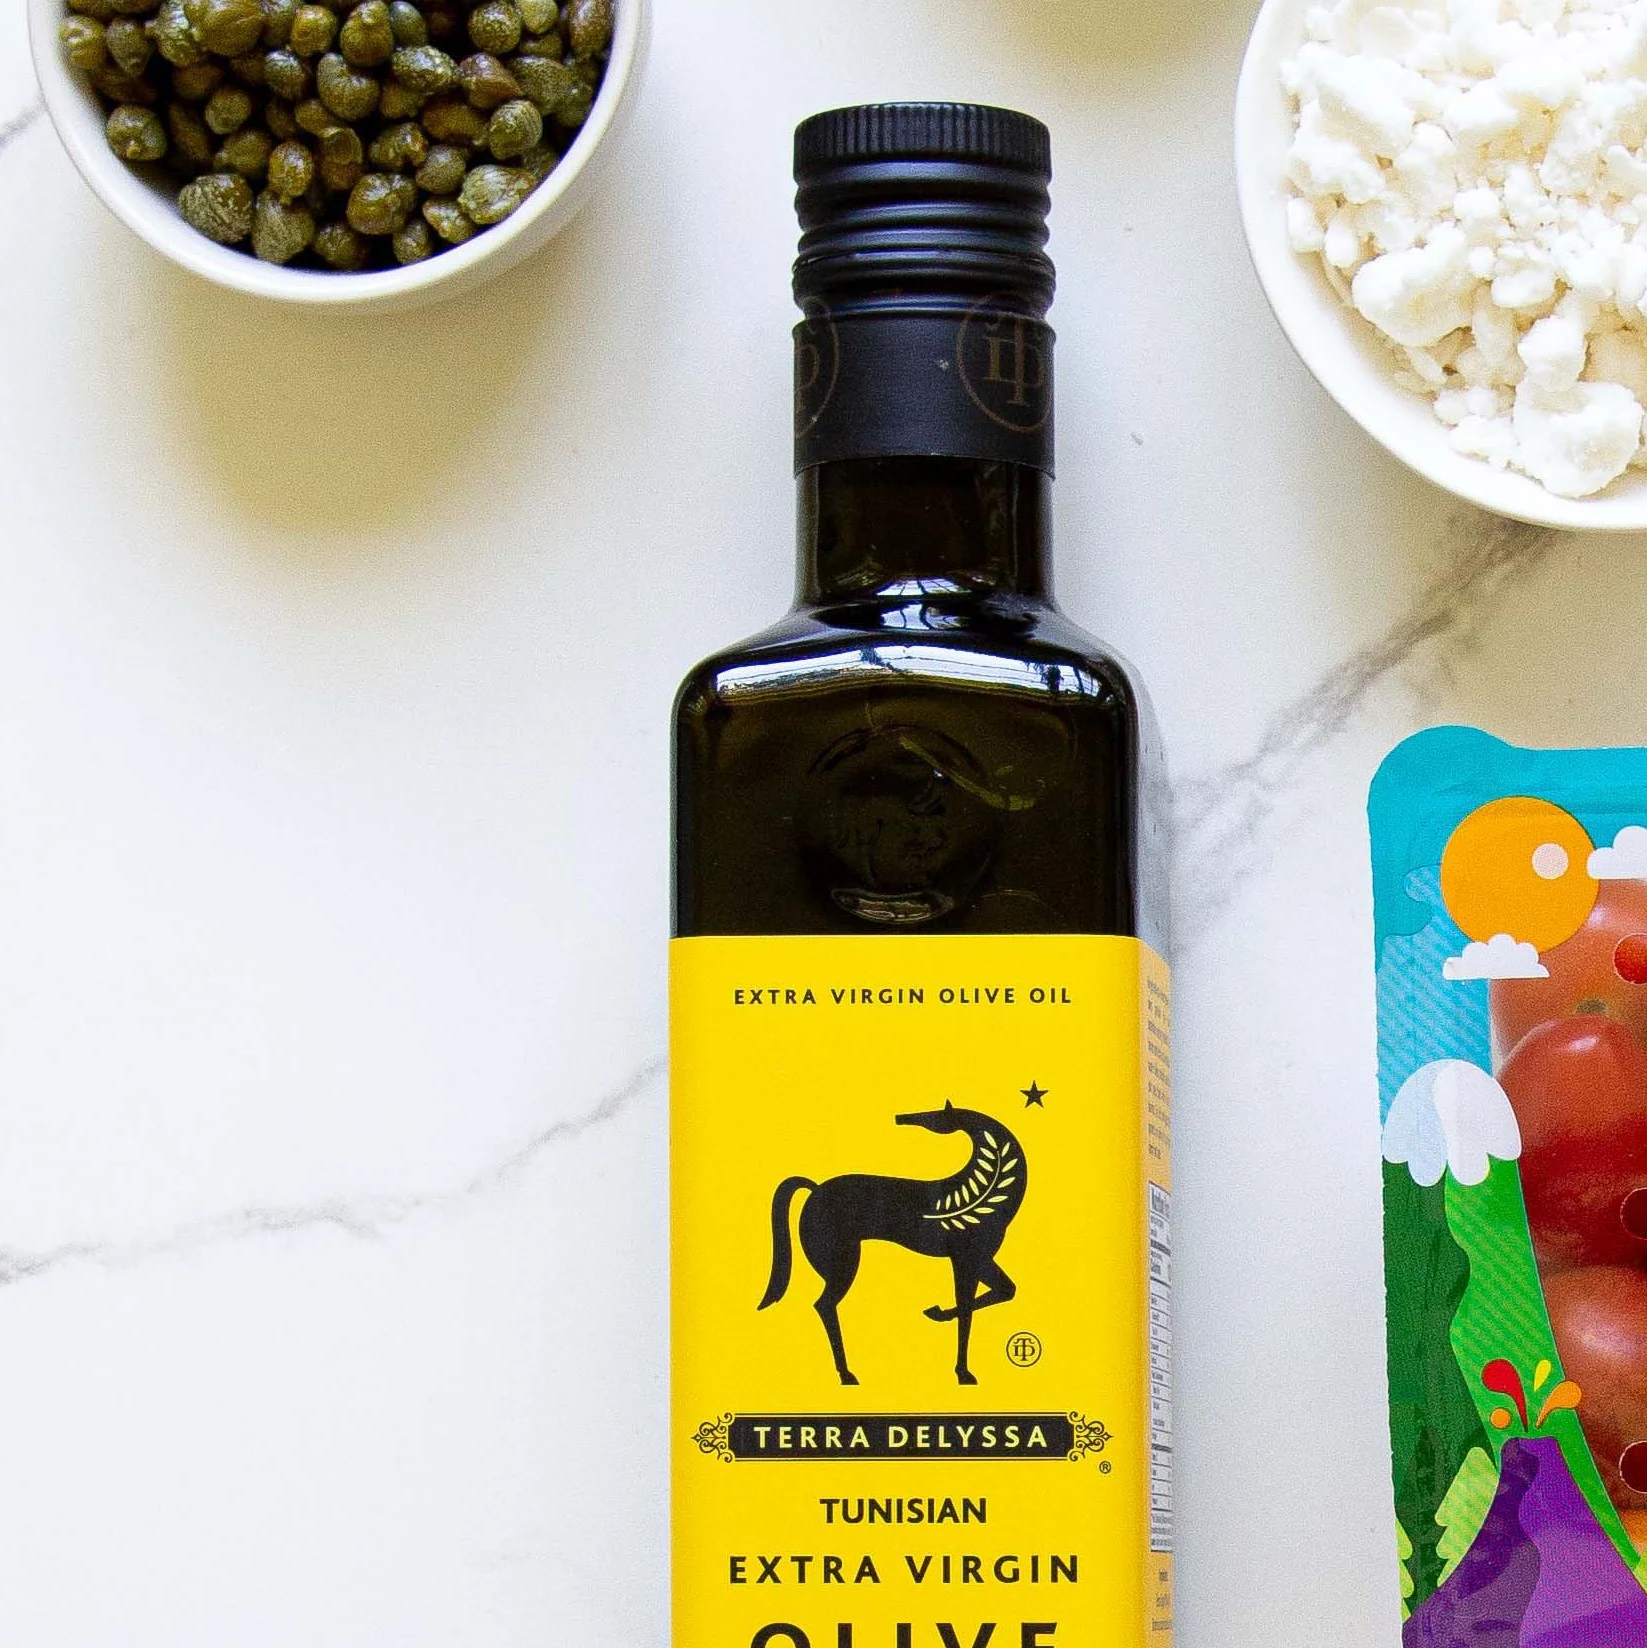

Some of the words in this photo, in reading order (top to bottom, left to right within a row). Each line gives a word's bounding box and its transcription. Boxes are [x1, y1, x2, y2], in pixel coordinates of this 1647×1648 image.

[734, 990, 816, 1004] EXTRA
[832, 989, 924, 1004] VIRGIN
[939, 988, 1015, 1004] OLIVE
[1029, 988, 1071, 1003] OIL
[754, 1427, 870, 1447] TERRA
[887, 1426, 1048, 1447] DELYSSA
[820, 1498, 986, 1524] TUNISIAN
[730, 1556, 881, 1584] EXTRA
[905, 1555, 1078, 1584] VIRGIN
